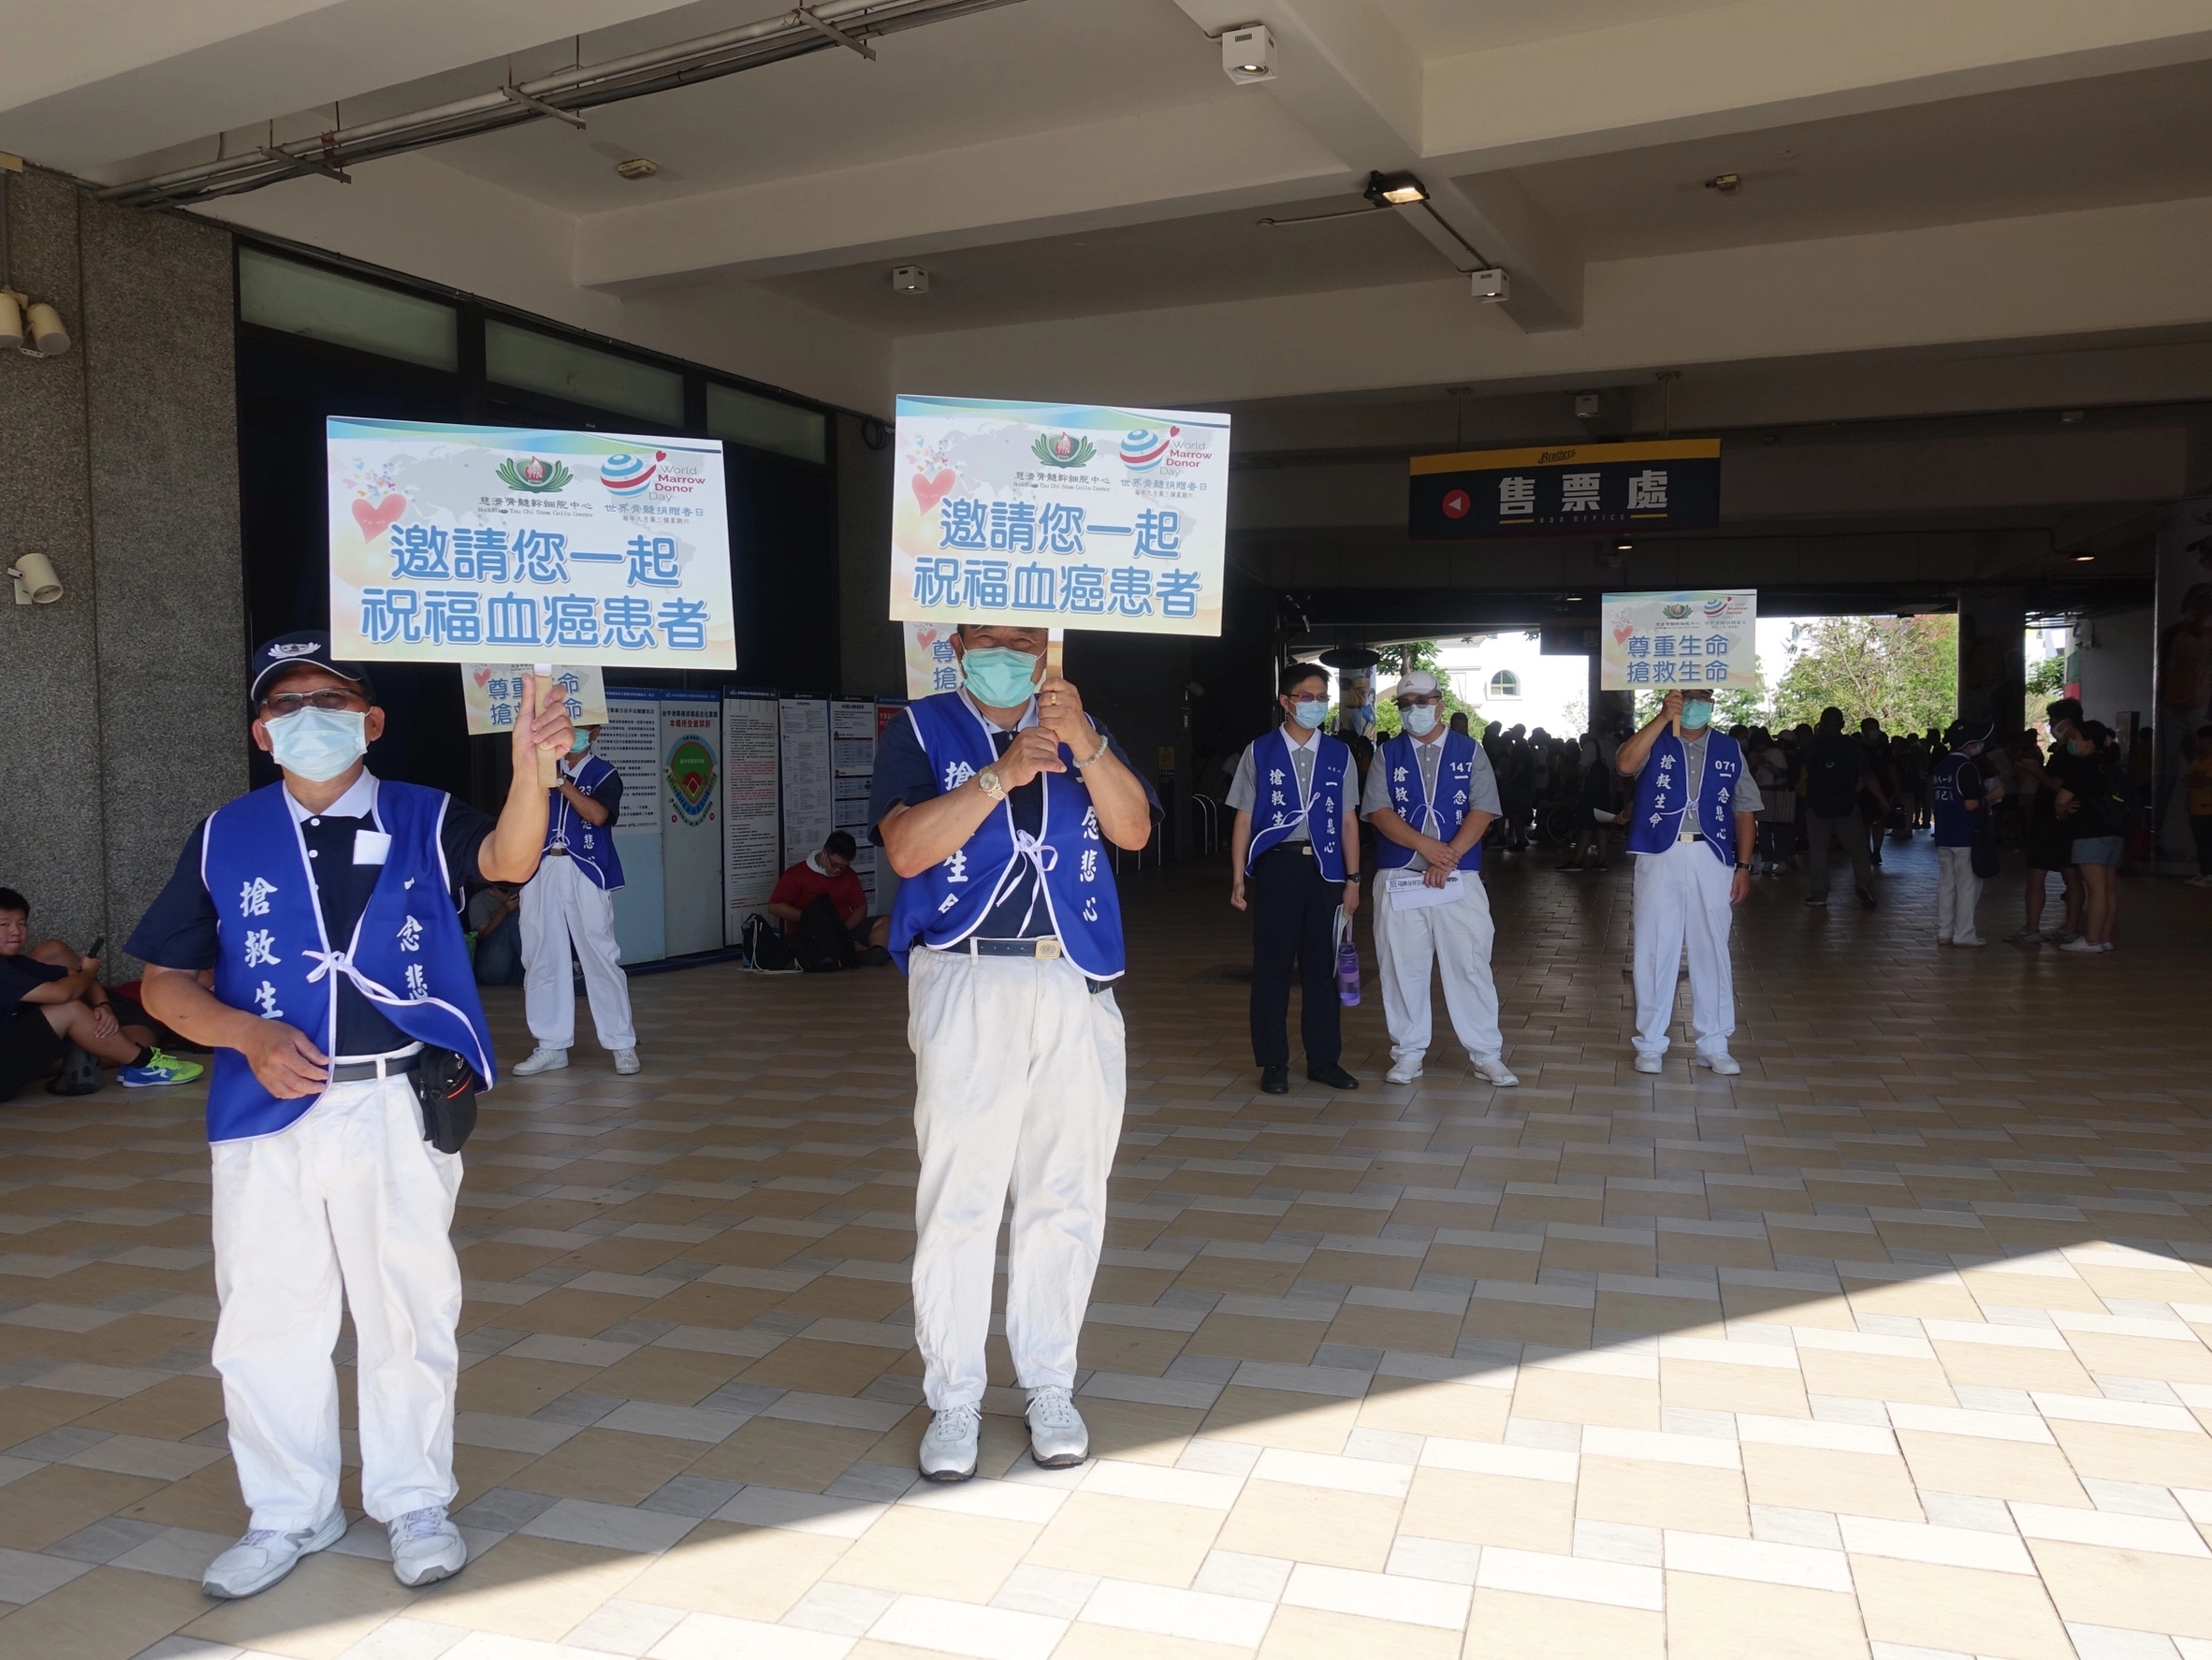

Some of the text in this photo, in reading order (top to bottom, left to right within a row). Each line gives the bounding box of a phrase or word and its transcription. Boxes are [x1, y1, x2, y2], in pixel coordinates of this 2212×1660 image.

[1170, 449, 1213, 459] Marrow
[1172, 440, 1206, 450] World
[1537, 448, 1576, 464] Brothers
[660, 464, 697, 475] World
[1159, 466, 1182, 478] Day
[1166, 458, 1201, 468] Donor
[654, 483, 693, 492] Donor
[658, 473, 706, 485] Marrow
[478, 496, 593, 510] 慈濟骨髓幹細胞中心
[648, 491, 673, 503] Day
[1498, 470, 1668, 515] 售票處
[604, 503, 704, 517] 世界骨髓捐贈者日
[1574, 514, 1625, 523] OFFICE
[939, 497, 1180, 559] 邀請您一起
[390, 523, 681, 588] 邀請您一起
[912, 557, 1201, 619] 祝福血癌患者
[359, 587, 710, 650] 祝福血癌患者
[1627, 633, 1729, 659] 尊重生命
[932, 666, 957, 691] 搶
[1627, 659, 1729, 684] 搶救生命
[487, 672, 580, 700] 尊重命
[490, 697, 584, 725] 搶命
[1449, 762, 1473, 774] 147
[1714, 760, 1736, 773] 071
[1649, 753, 1677, 828] 搶救生命
[1324, 780, 1338, 853] 一念悲心
[1715, 773, 1732, 840] 一念悲心
[938, 761, 976, 914] 搶生
[239, 877, 284, 1020] 搶救生
